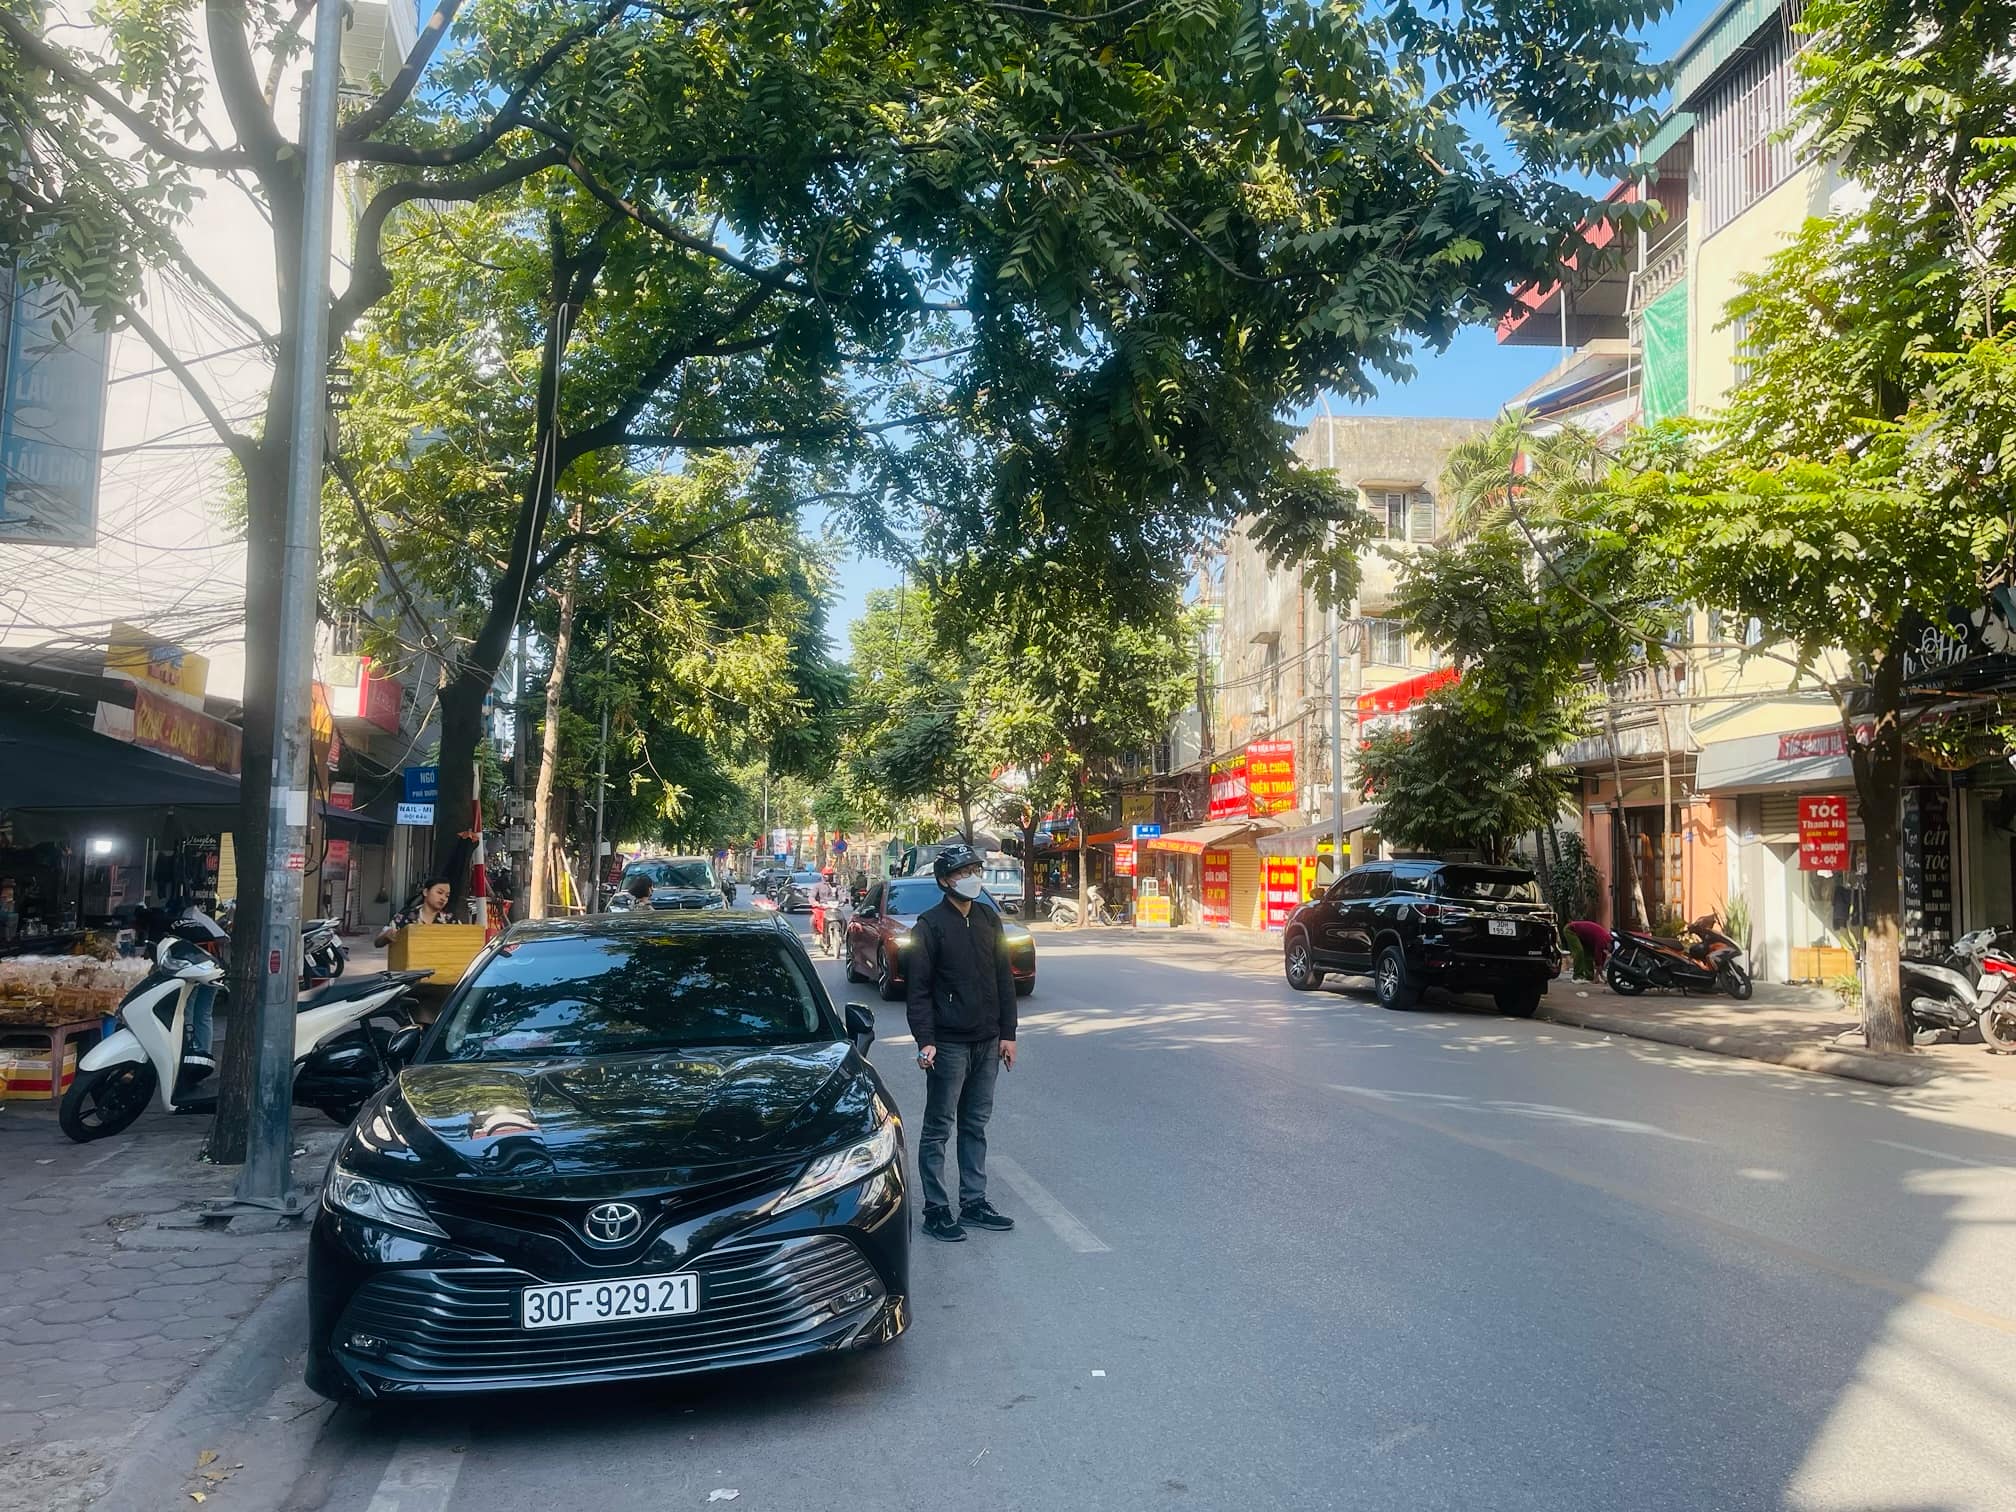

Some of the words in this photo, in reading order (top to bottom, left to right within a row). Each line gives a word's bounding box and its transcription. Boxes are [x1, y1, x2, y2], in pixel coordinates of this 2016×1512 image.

[1809, 801, 1839, 818] TÓC
[1802, 820, 1829, 829] Thanh
[1832, 819, 1845, 829] Hà
[528, 1278, 690, 1324] 30F-929.21
